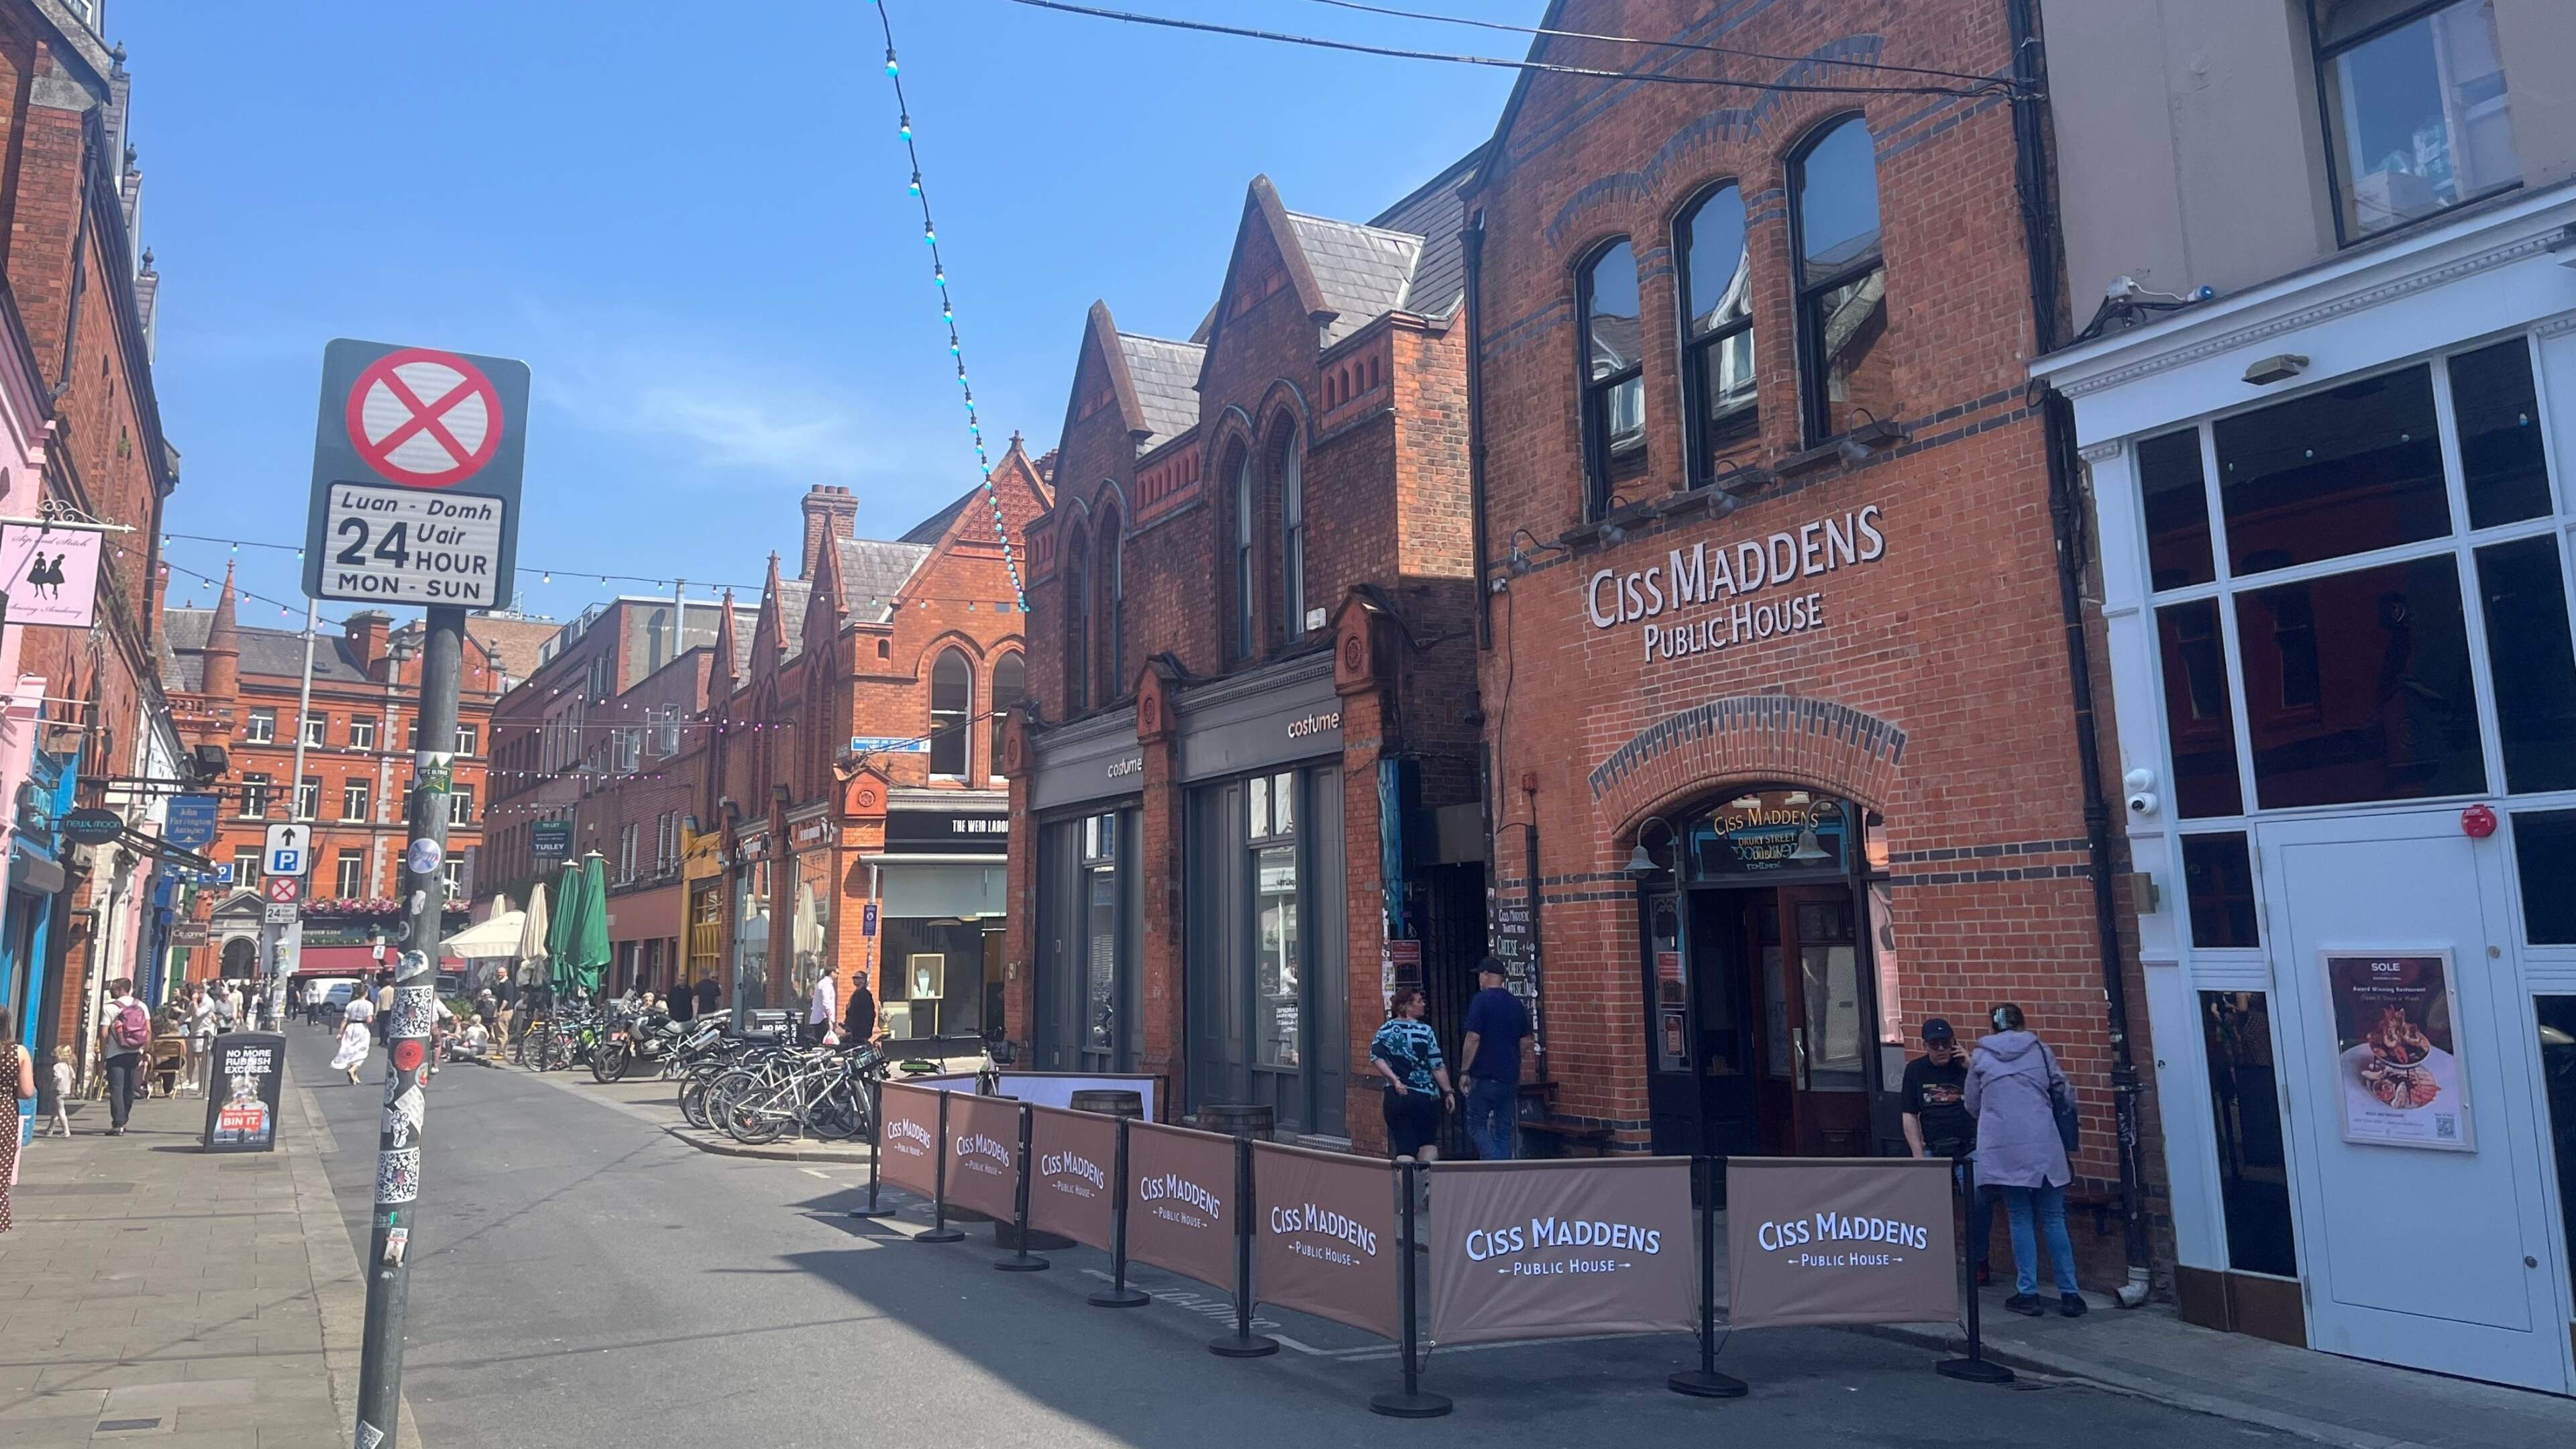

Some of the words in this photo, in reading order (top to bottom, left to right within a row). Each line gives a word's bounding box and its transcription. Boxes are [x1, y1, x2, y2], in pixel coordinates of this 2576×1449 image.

[341, 492, 398, 512] Luan
[427, 500, 491, 521] Domh
[336, 517, 409, 568] 24
[417, 523, 466, 545] Uair
[416, 551, 486, 575] HOUR
[1589, 567, 1664, 628] CISS
[1670, 505, 1884, 610] MADDENS
[338, 574, 399, 594] MON
[426, 580, 480, 599] SUN
[1644, 616, 1727, 662] PUBLIC
[1731, 592, 1823, 643] HOUSE
[1288, 712, 1340, 738] costume
[1108, 757, 1143, 778] costume
[953, 820, 965, 833] THE
[968, 820, 986, 833] WEIR
[1714, 814, 1743, 836] CISS
[1738, 836, 1764, 846] DRURY
[1765, 833, 1794, 843] STREET
[278, 852, 294, 869] P
[268, 908, 280, 917] 24
[1497, 935, 1519, 956] CHEESE
[1508, 959, 1526, 976] CHEESE
[2371, 963, 2400, 971] SOLE
[223, 1117, 243, 1126] BIN
[247, 1116, 259, 1126] IT.
[1041, 1154, 1062, 1176] CISS
[1063, 1150, 1104, 1190] MADDENS
[1140, 1177, 1164, 1201] CISS
[1167, 1173, 1221, 1220] MADDENS
[1159, 1207, 1179, 1222] PUBLIC
[1181, 1212, 1201, 1228] HOUSE
[1271, 1206, 1301, 1234] CISS
[1304, 1203, 1377, 1256] MADDENS
[1466, 1226, 1525, 1261] CISS
[1532, 1217, 1662, 1254] MADDENS
[1758, 1220, 1811, 1251] CISS
[1815, 1212, 1928, 1250] MADDENS
[1296, 1241, 1323, 1258] PUBLIC
[1326, 1247, 1351, 1265] HOUSE
[1801, 1253, 1845, 1267] PUBLIC
[1849, 1252, 1890, 1265] HOUSE
[1514, 1262, 1563, 1276] PUBLIC
[1570, 1259, 1615, 1273] HOUSE
